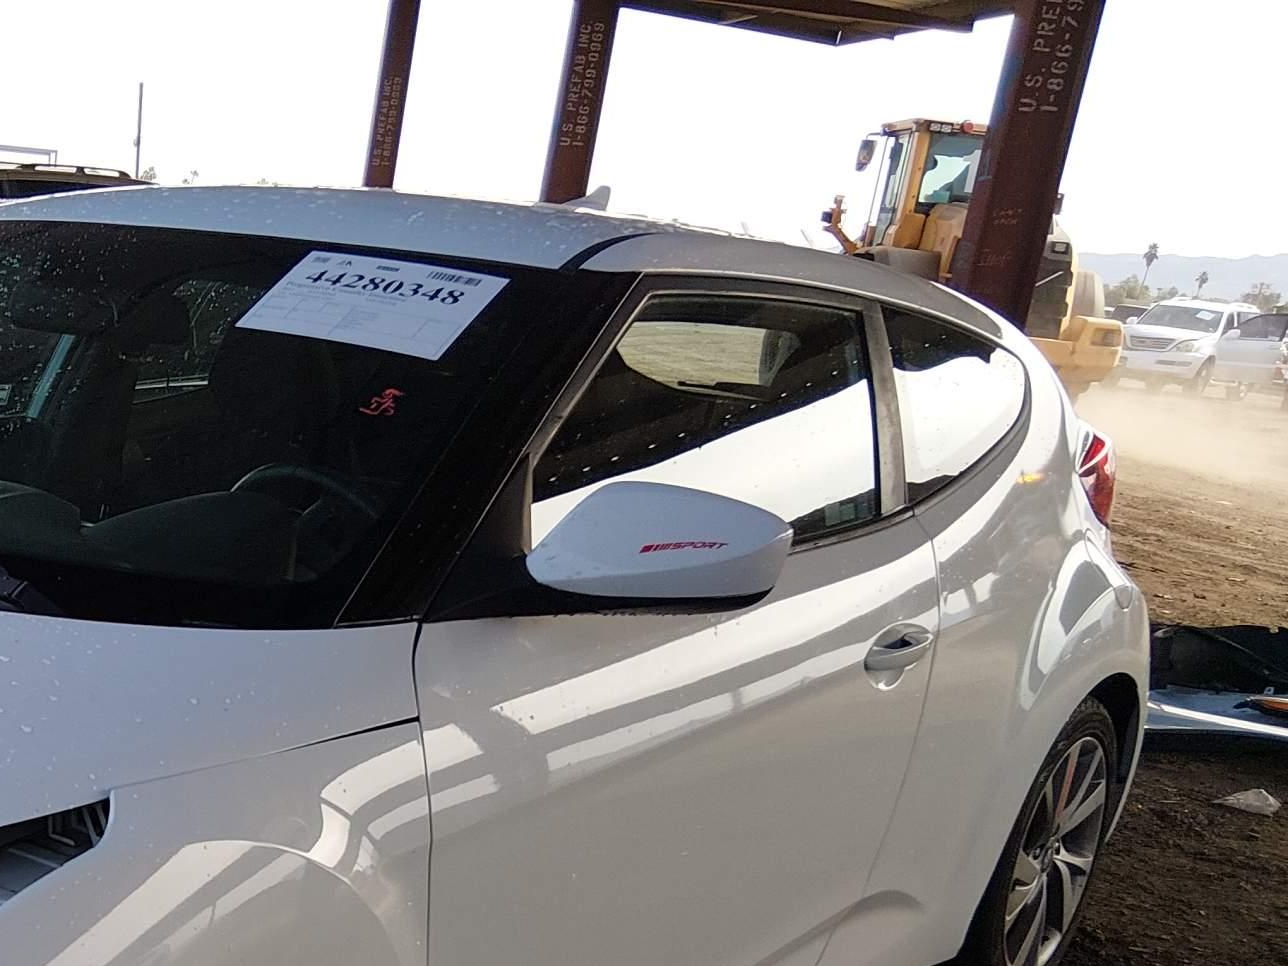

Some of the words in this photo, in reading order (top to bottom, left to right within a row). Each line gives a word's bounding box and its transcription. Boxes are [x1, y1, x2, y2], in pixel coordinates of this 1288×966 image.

[559, 121, 574, 146] U.S.
[567, 55, 585, 111] PREFAB
[578, 20, 593, 47] INC.
[1018, 67, 1046, 112] U.S.
[305, 269, 465, 305] 44280348
